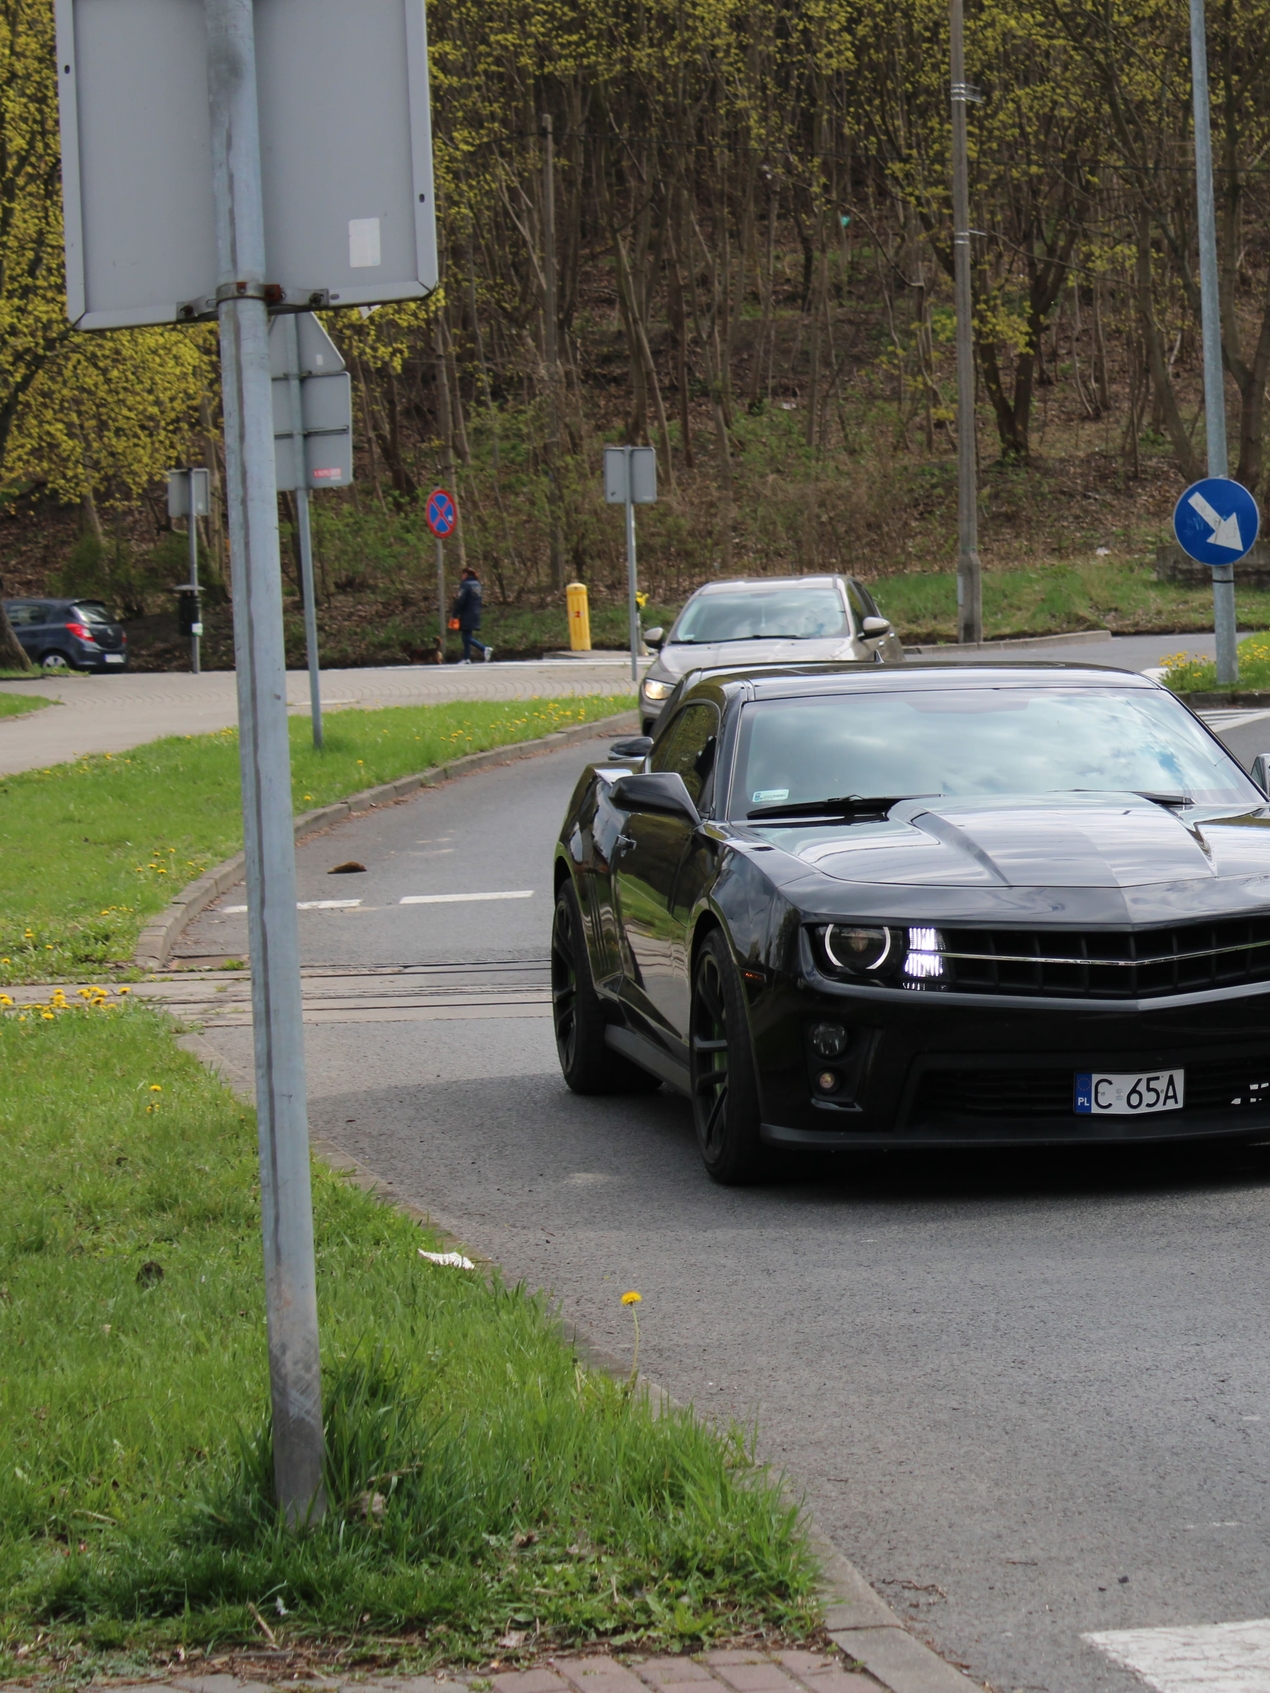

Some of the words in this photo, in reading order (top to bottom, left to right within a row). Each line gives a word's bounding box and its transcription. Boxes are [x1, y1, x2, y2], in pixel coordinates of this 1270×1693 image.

[1077, 1097, 1090, 1106] PL
[1094, 1078, 1113, 1110] C
[1126, 1074, 1179, 1110] 65A
